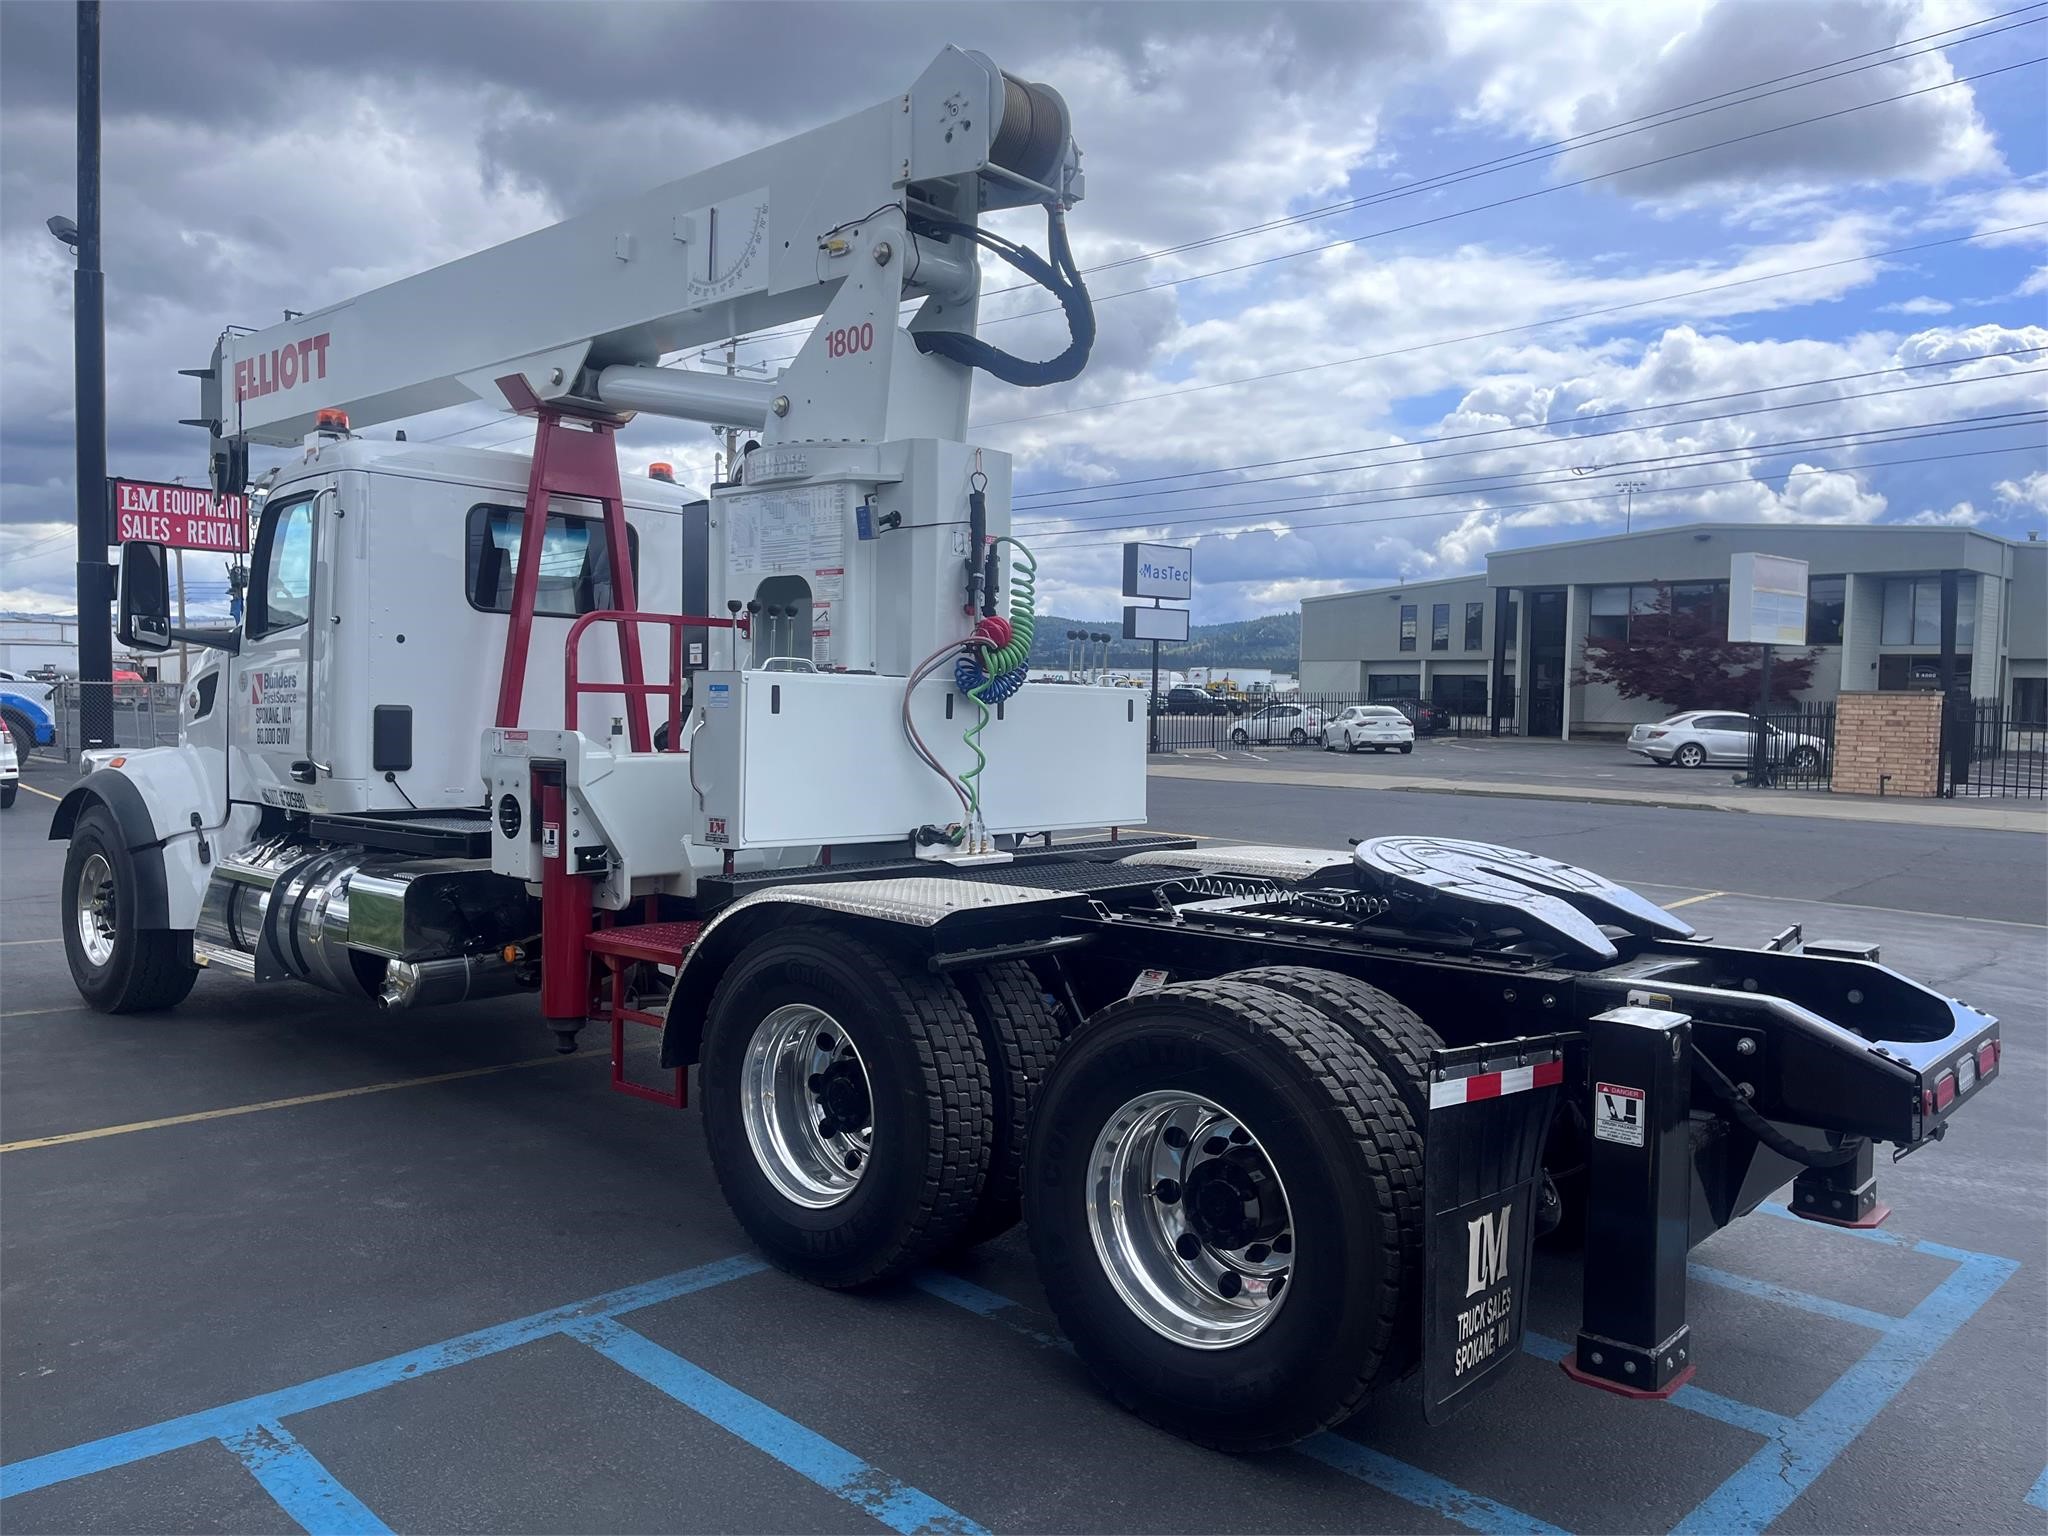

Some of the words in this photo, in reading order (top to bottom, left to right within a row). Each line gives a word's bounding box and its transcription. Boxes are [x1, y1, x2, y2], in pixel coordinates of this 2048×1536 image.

[825, 322, 873, 359] 1800
[234, 332, 330, 403] ELLIOTT
[120, 486, 159, 513] L&M
[163, 489, 241, 519] EQUIPMENT
[122, 514, 170, 541] SALES
[187, 520, 241, 547] RENTAL
[1143, 563, 1189, 582] MasTec
[263, 672, 297, 689] Builders
[263, 691, 297, 704] FirstSource
[281, 706, 292, 723] WA
[276, 727, 291, 745] GVW
[1611, 1087, 1639, 1097] DANGER
[1457, 1301, 1486, 1342] TRUCK
[1486, 1287, 1512, 1325] SALES
[1455, 1327, 1496, 1377] SPOKANE,
[1498, 1318, 1510, 1348] WA
